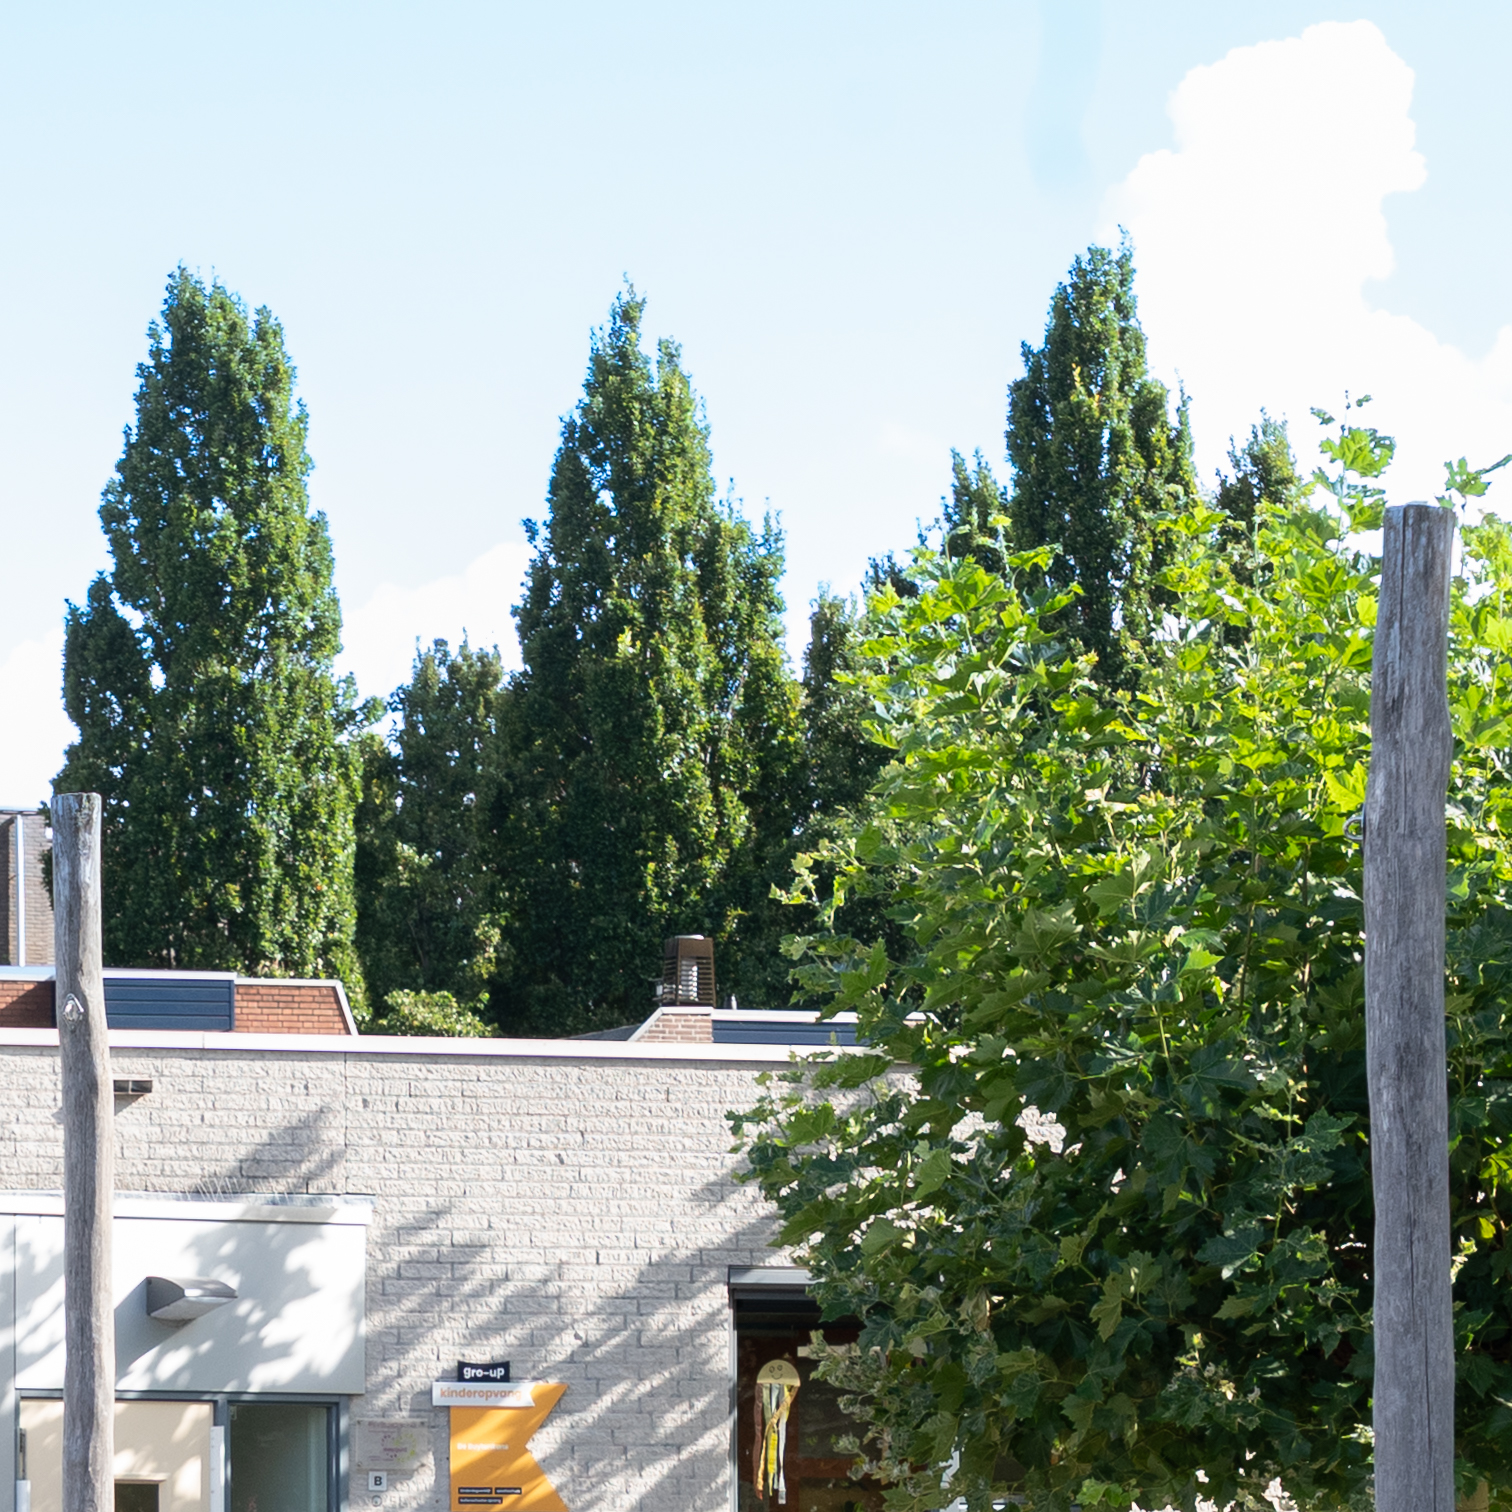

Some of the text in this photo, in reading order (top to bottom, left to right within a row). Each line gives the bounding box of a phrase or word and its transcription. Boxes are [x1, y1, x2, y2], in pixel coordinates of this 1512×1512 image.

[463, 1367, 505, 1379] gro-up
[440, 1387, 522, 1401] kinderopvang
[374, 1476, 383, 1486] B
